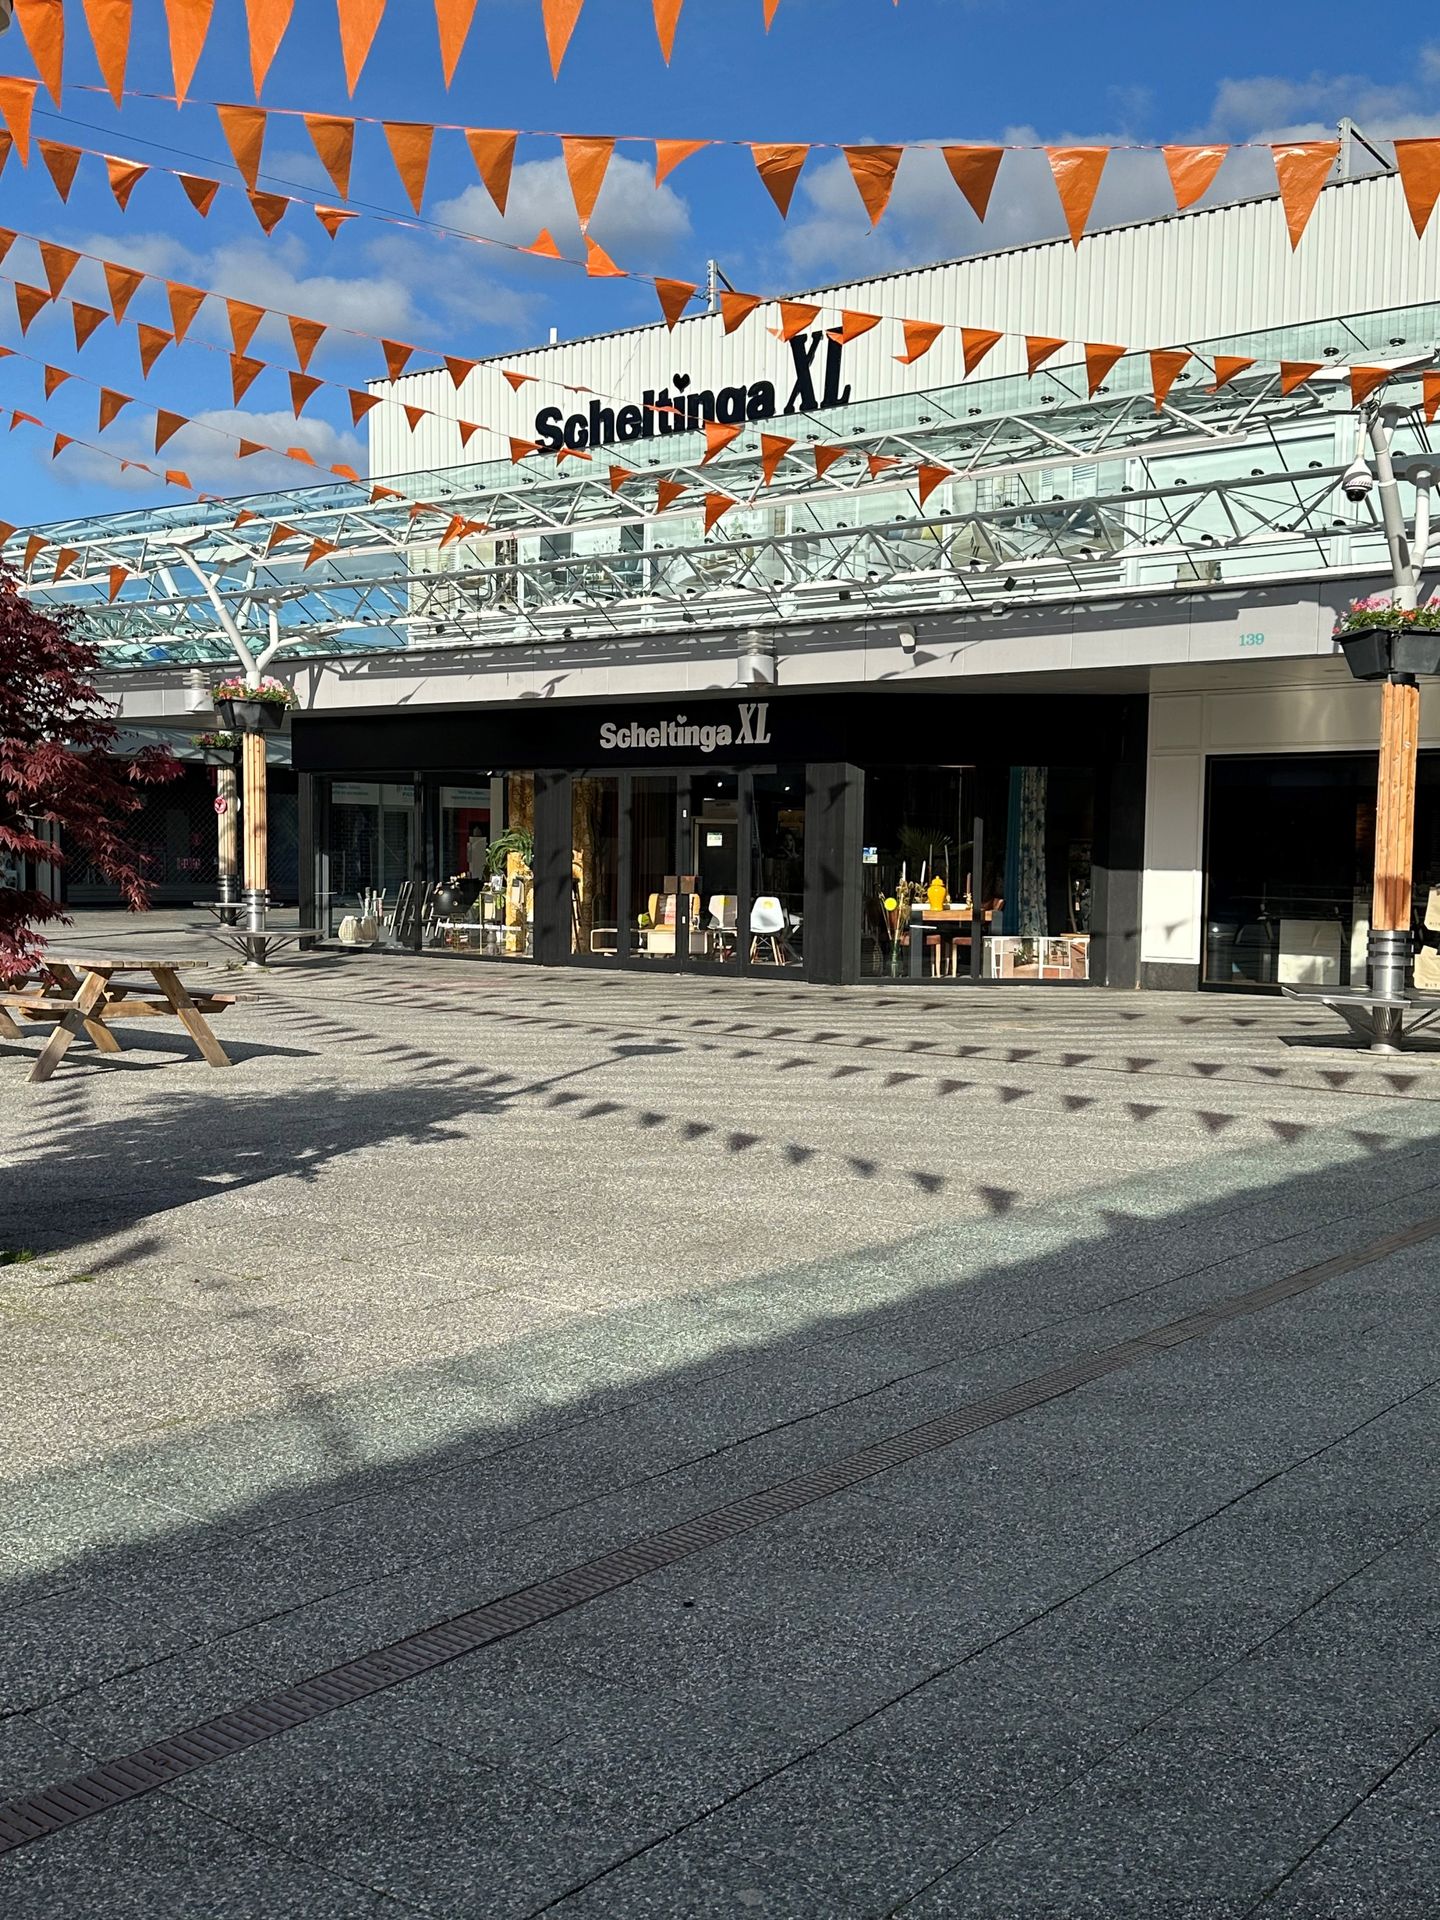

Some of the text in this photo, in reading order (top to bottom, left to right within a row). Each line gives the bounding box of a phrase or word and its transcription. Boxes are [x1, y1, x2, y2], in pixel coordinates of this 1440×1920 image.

[535, 326, 851, 454] Scheltinga XL
[1239, 633, 1265, 647] 139
[599, 703, 771, 752] Scheltinga XL
